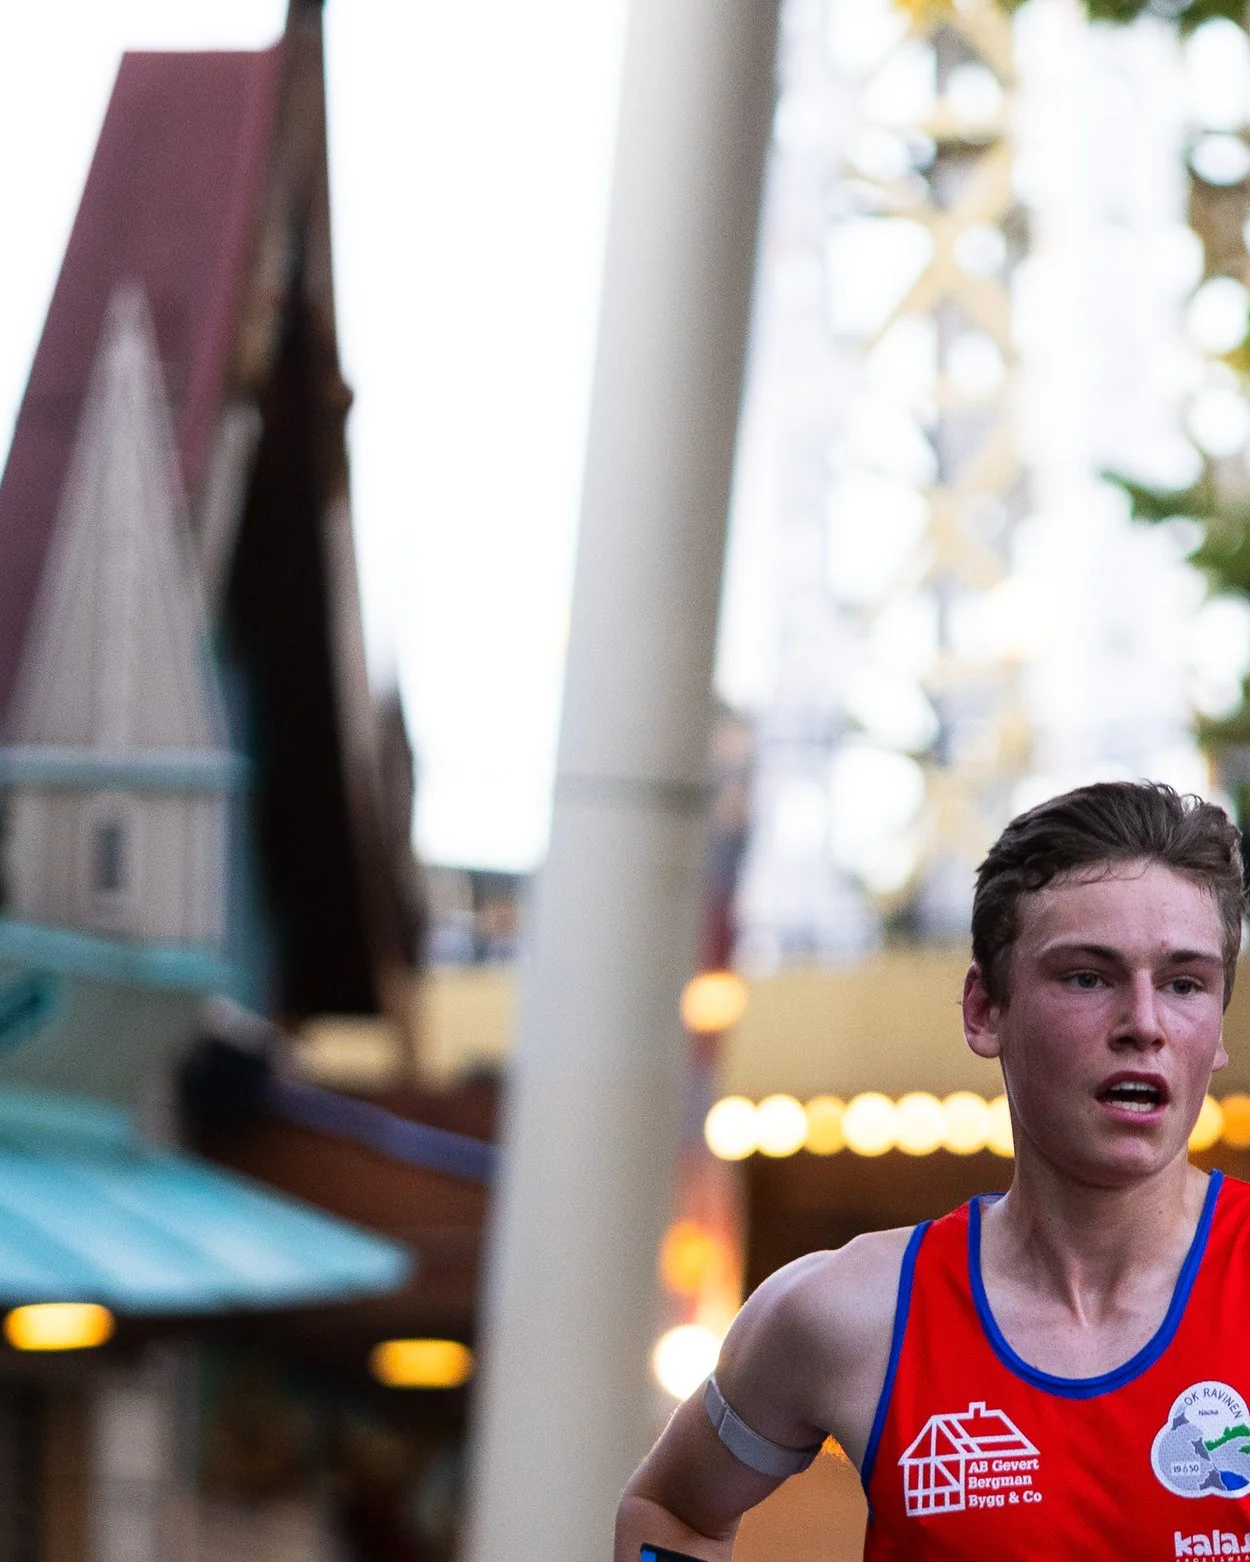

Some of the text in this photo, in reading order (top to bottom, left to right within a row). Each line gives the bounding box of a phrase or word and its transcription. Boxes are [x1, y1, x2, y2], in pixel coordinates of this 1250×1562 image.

[1184, 1387, 1243, 1419] OK RAVINEN
[968, 1458, 1040, 1474] AB Gevert
[968, 1475, 1033, 1490] Bergman
[968, 1490, 1043, 1509] Bygg & Co
